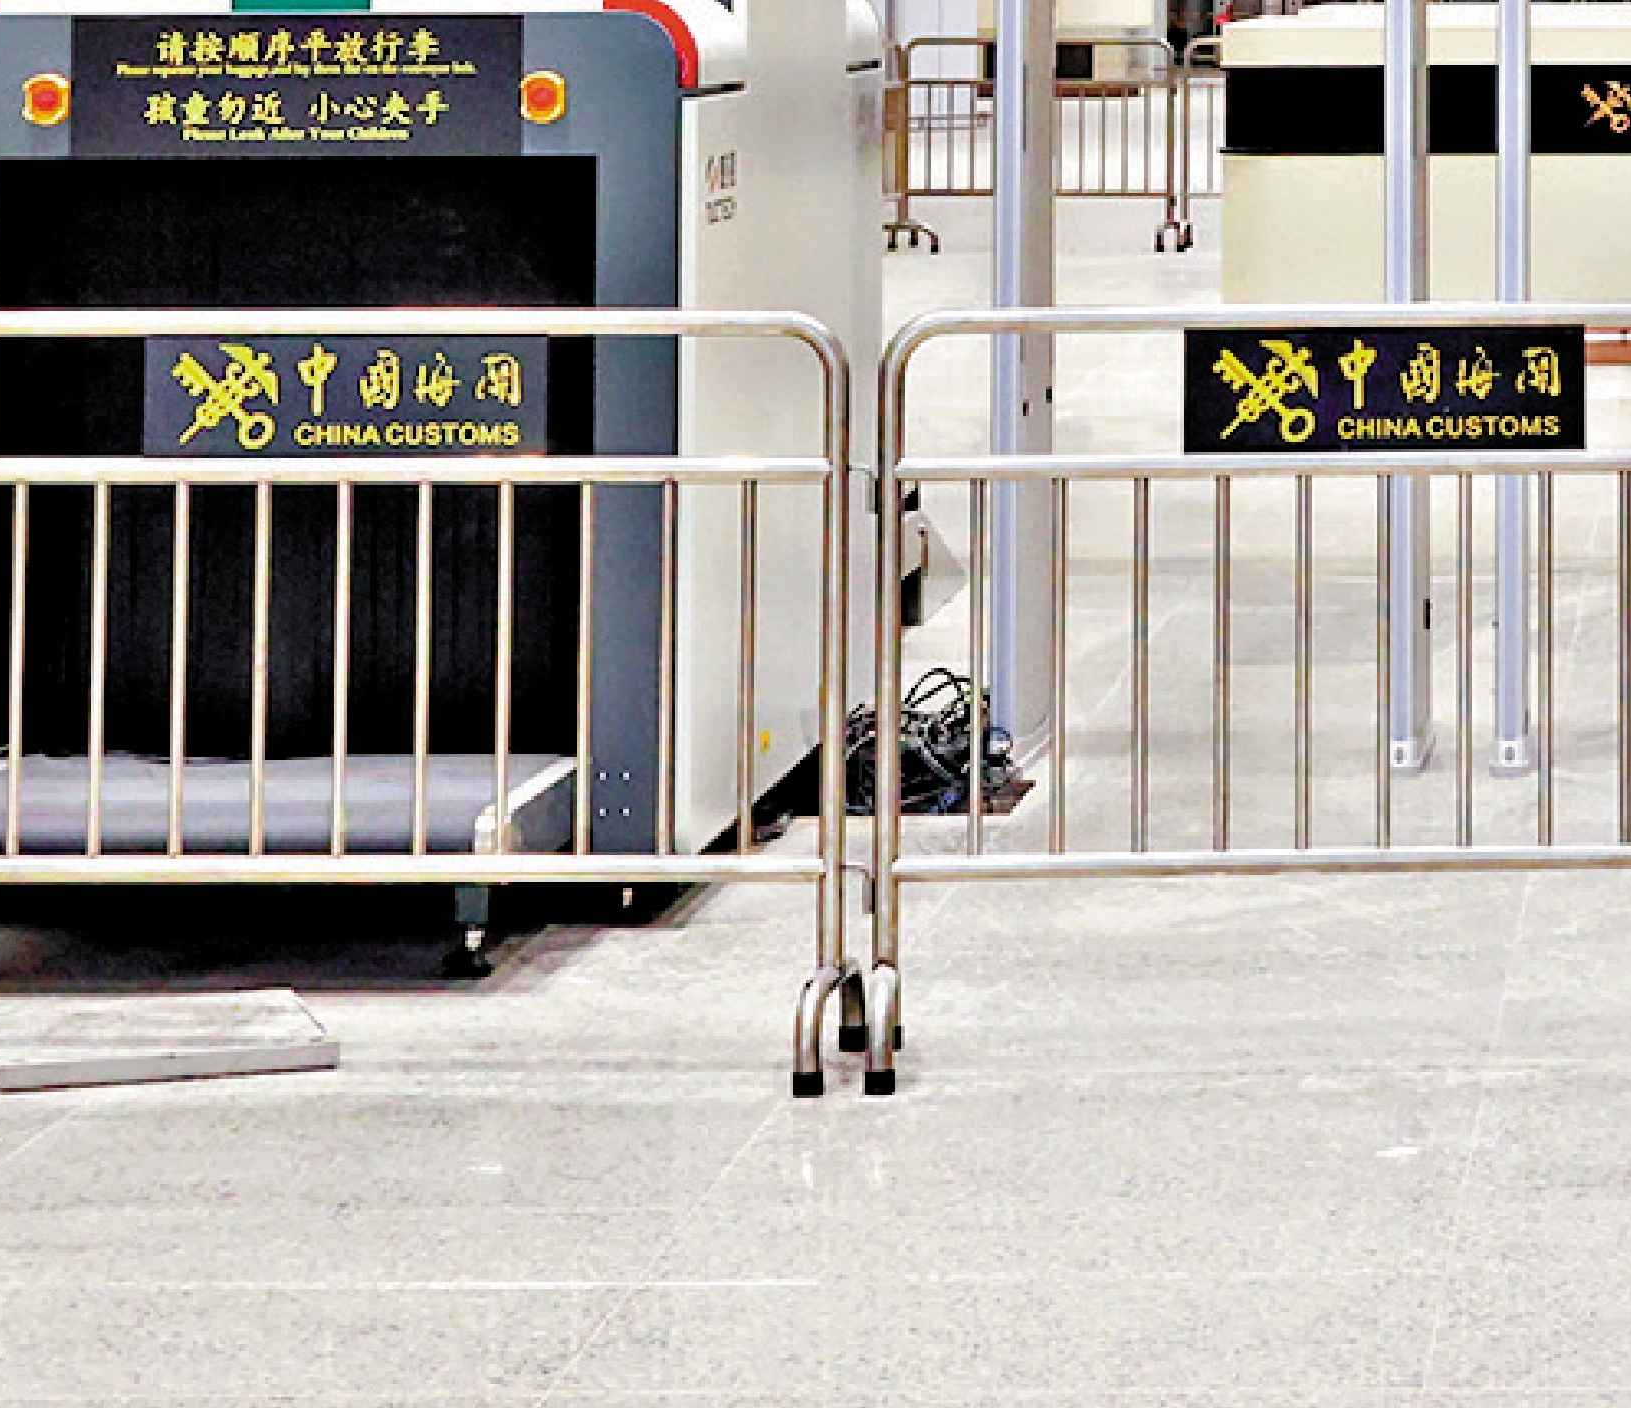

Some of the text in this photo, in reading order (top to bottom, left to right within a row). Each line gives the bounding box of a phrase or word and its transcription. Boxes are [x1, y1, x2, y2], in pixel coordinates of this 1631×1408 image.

[311, 91, 449, 124] 小心夹手
[294, 422, 521, 445] CHINA CUSTOMS
[1338, 416, 1560, 439] CHINA CUSTOMS
